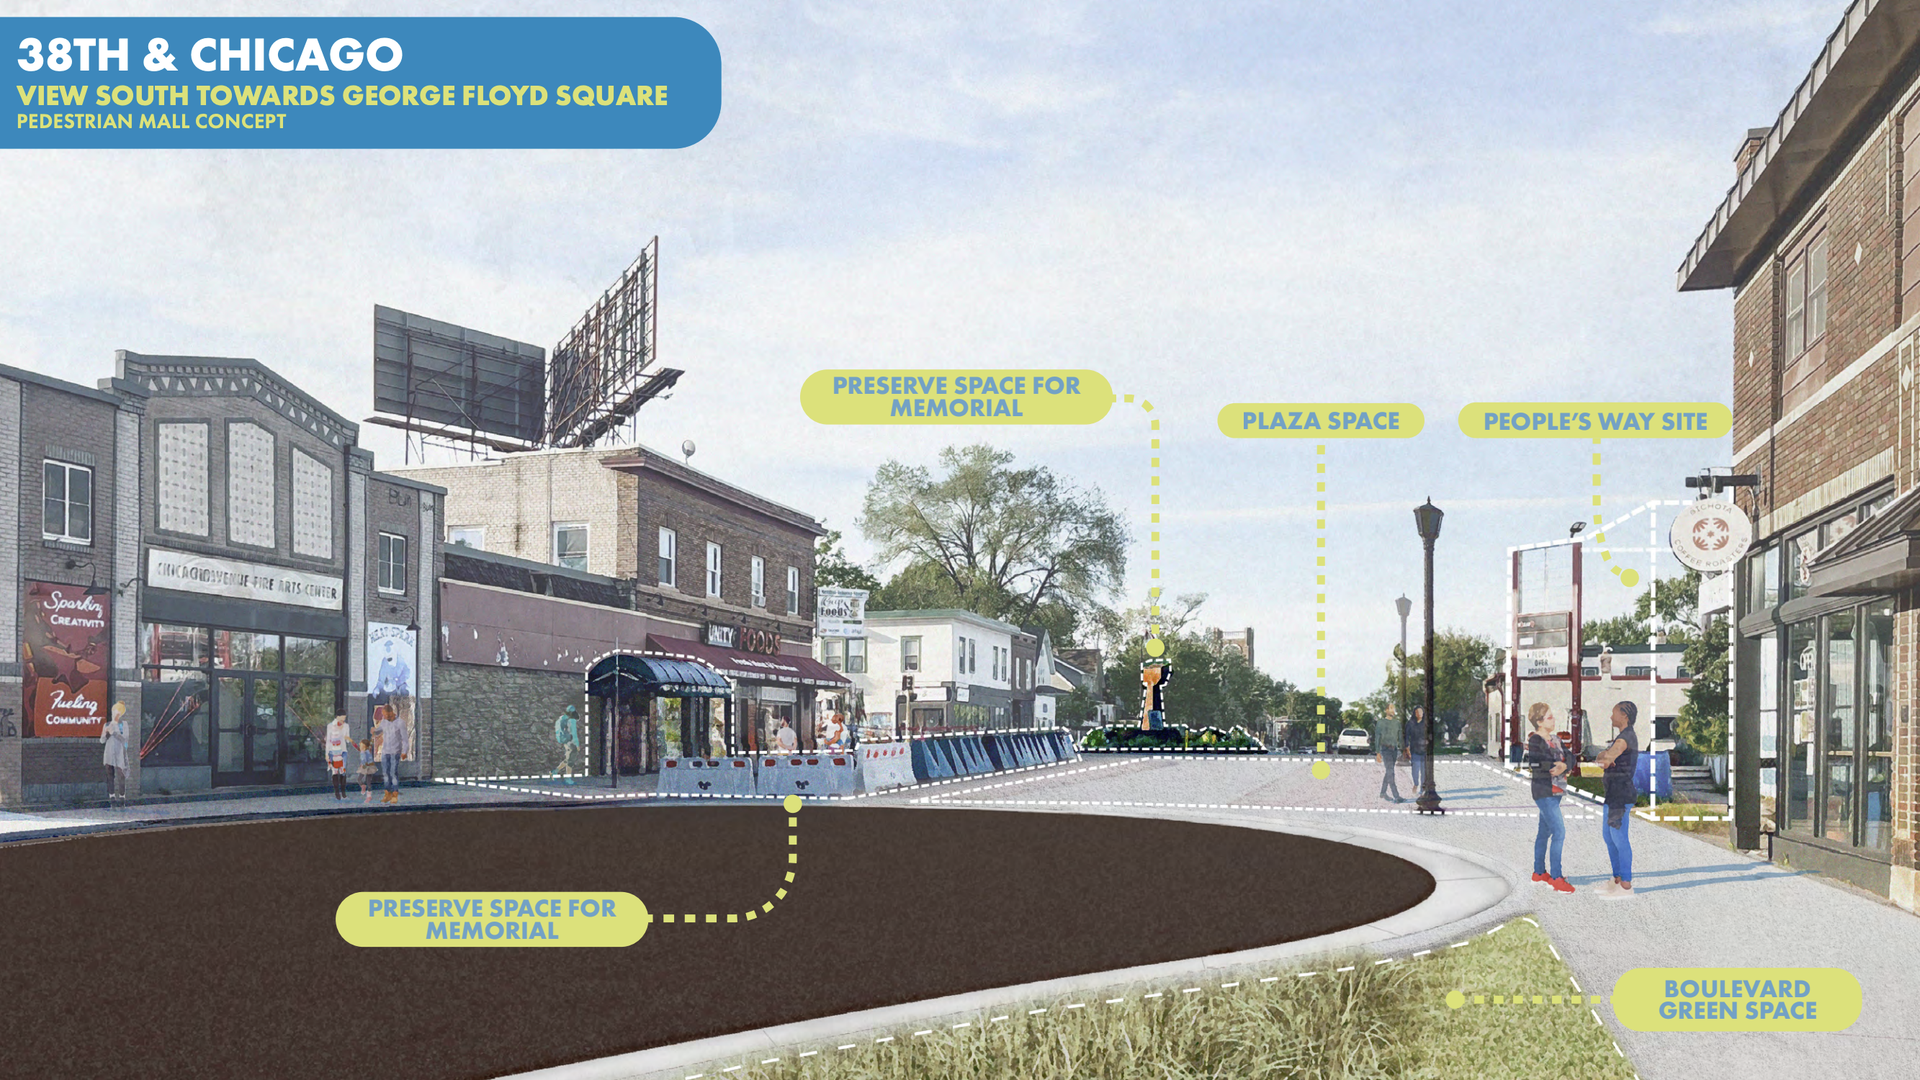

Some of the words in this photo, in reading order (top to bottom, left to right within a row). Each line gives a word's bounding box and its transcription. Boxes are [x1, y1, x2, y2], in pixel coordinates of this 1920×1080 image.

[1690, 503, 1732, 515] BICHOTA
[1675, 539, 1703, 567] COFFEE
[1705, 537, 1748, 568] ROASTERS
[279, 580, 301, 595] ARTS
[304, 584, 338, 600] CENTER
[44, 591, 103, 618] Sparking
[708, 624, 734, 643] UNITY
[739, 626, 781, 656] FOODS
[50, 689, 98, 716] Fueling
[45, 713, 104, 725] COMMUNITY
